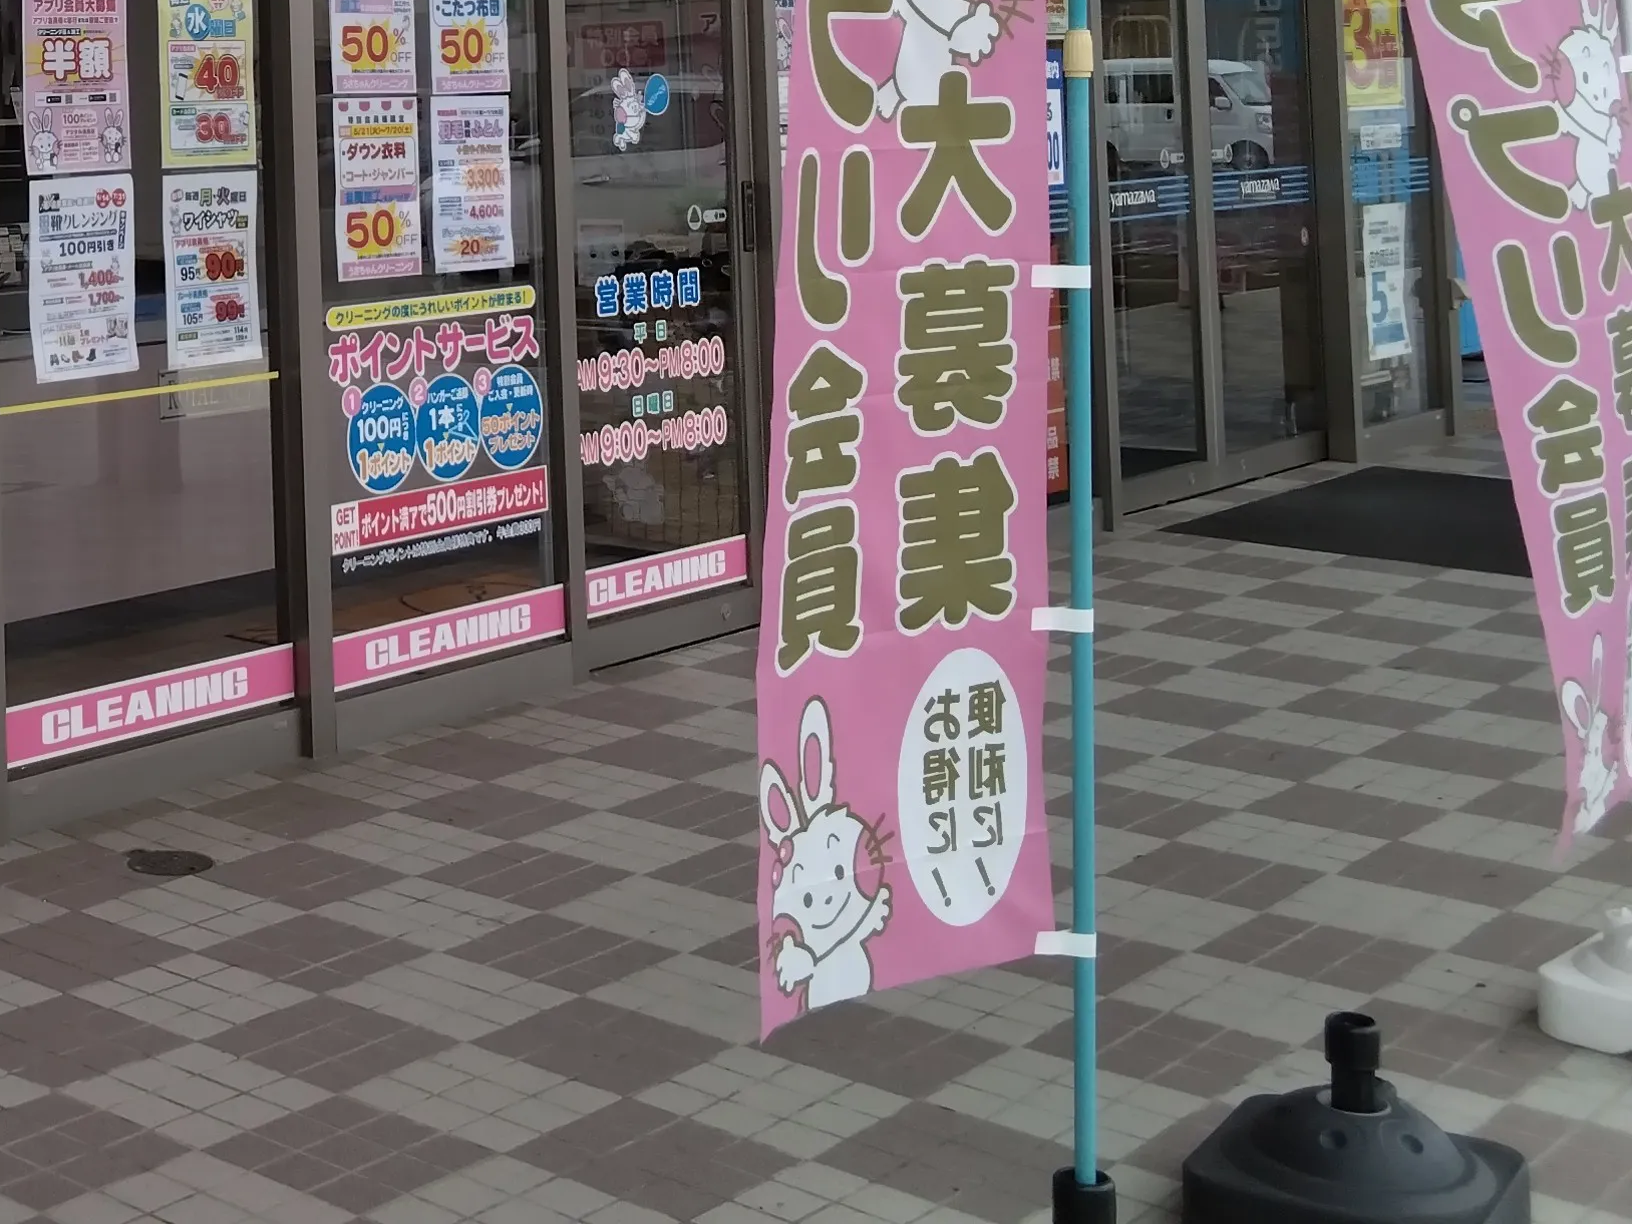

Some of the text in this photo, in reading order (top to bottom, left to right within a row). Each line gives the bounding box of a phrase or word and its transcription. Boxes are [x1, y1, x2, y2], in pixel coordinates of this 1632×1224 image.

[42, 38, 112, 81] 半額
[341, 26, 389, 63] 50
[390, 52, 412, 63] OFF
[441, 28, 484, 64] 50
[485, 52, 505, 63] OFF
[195, 54, 240, 93] 40
[195, 112, 231, 143] 30
[1110, 177, 1280, 212] yamazawa yamazawa
[346, 209, 394, 249] 50
[396, 233, 417, 246] OFF
[460, 239, 480, 255] 20
[594, 266, 701, 317] 営業時間
[633, 319, 668, 343] 平日
[328, 314, 540, 386] ポイントサービス
[362, 396, 404, 415] クリーニング
[428, 404, 455, 431] 1本
[357, 415, 401, 443] 100円
[356, 447, 412, 482] 1ポイント
[335, 506, 356, 526] GET
[588, 549, 726, 607] CLEANING
[365, 603, 531, 672] CLEANING
[40, 666, 248, 746] CLEANING
